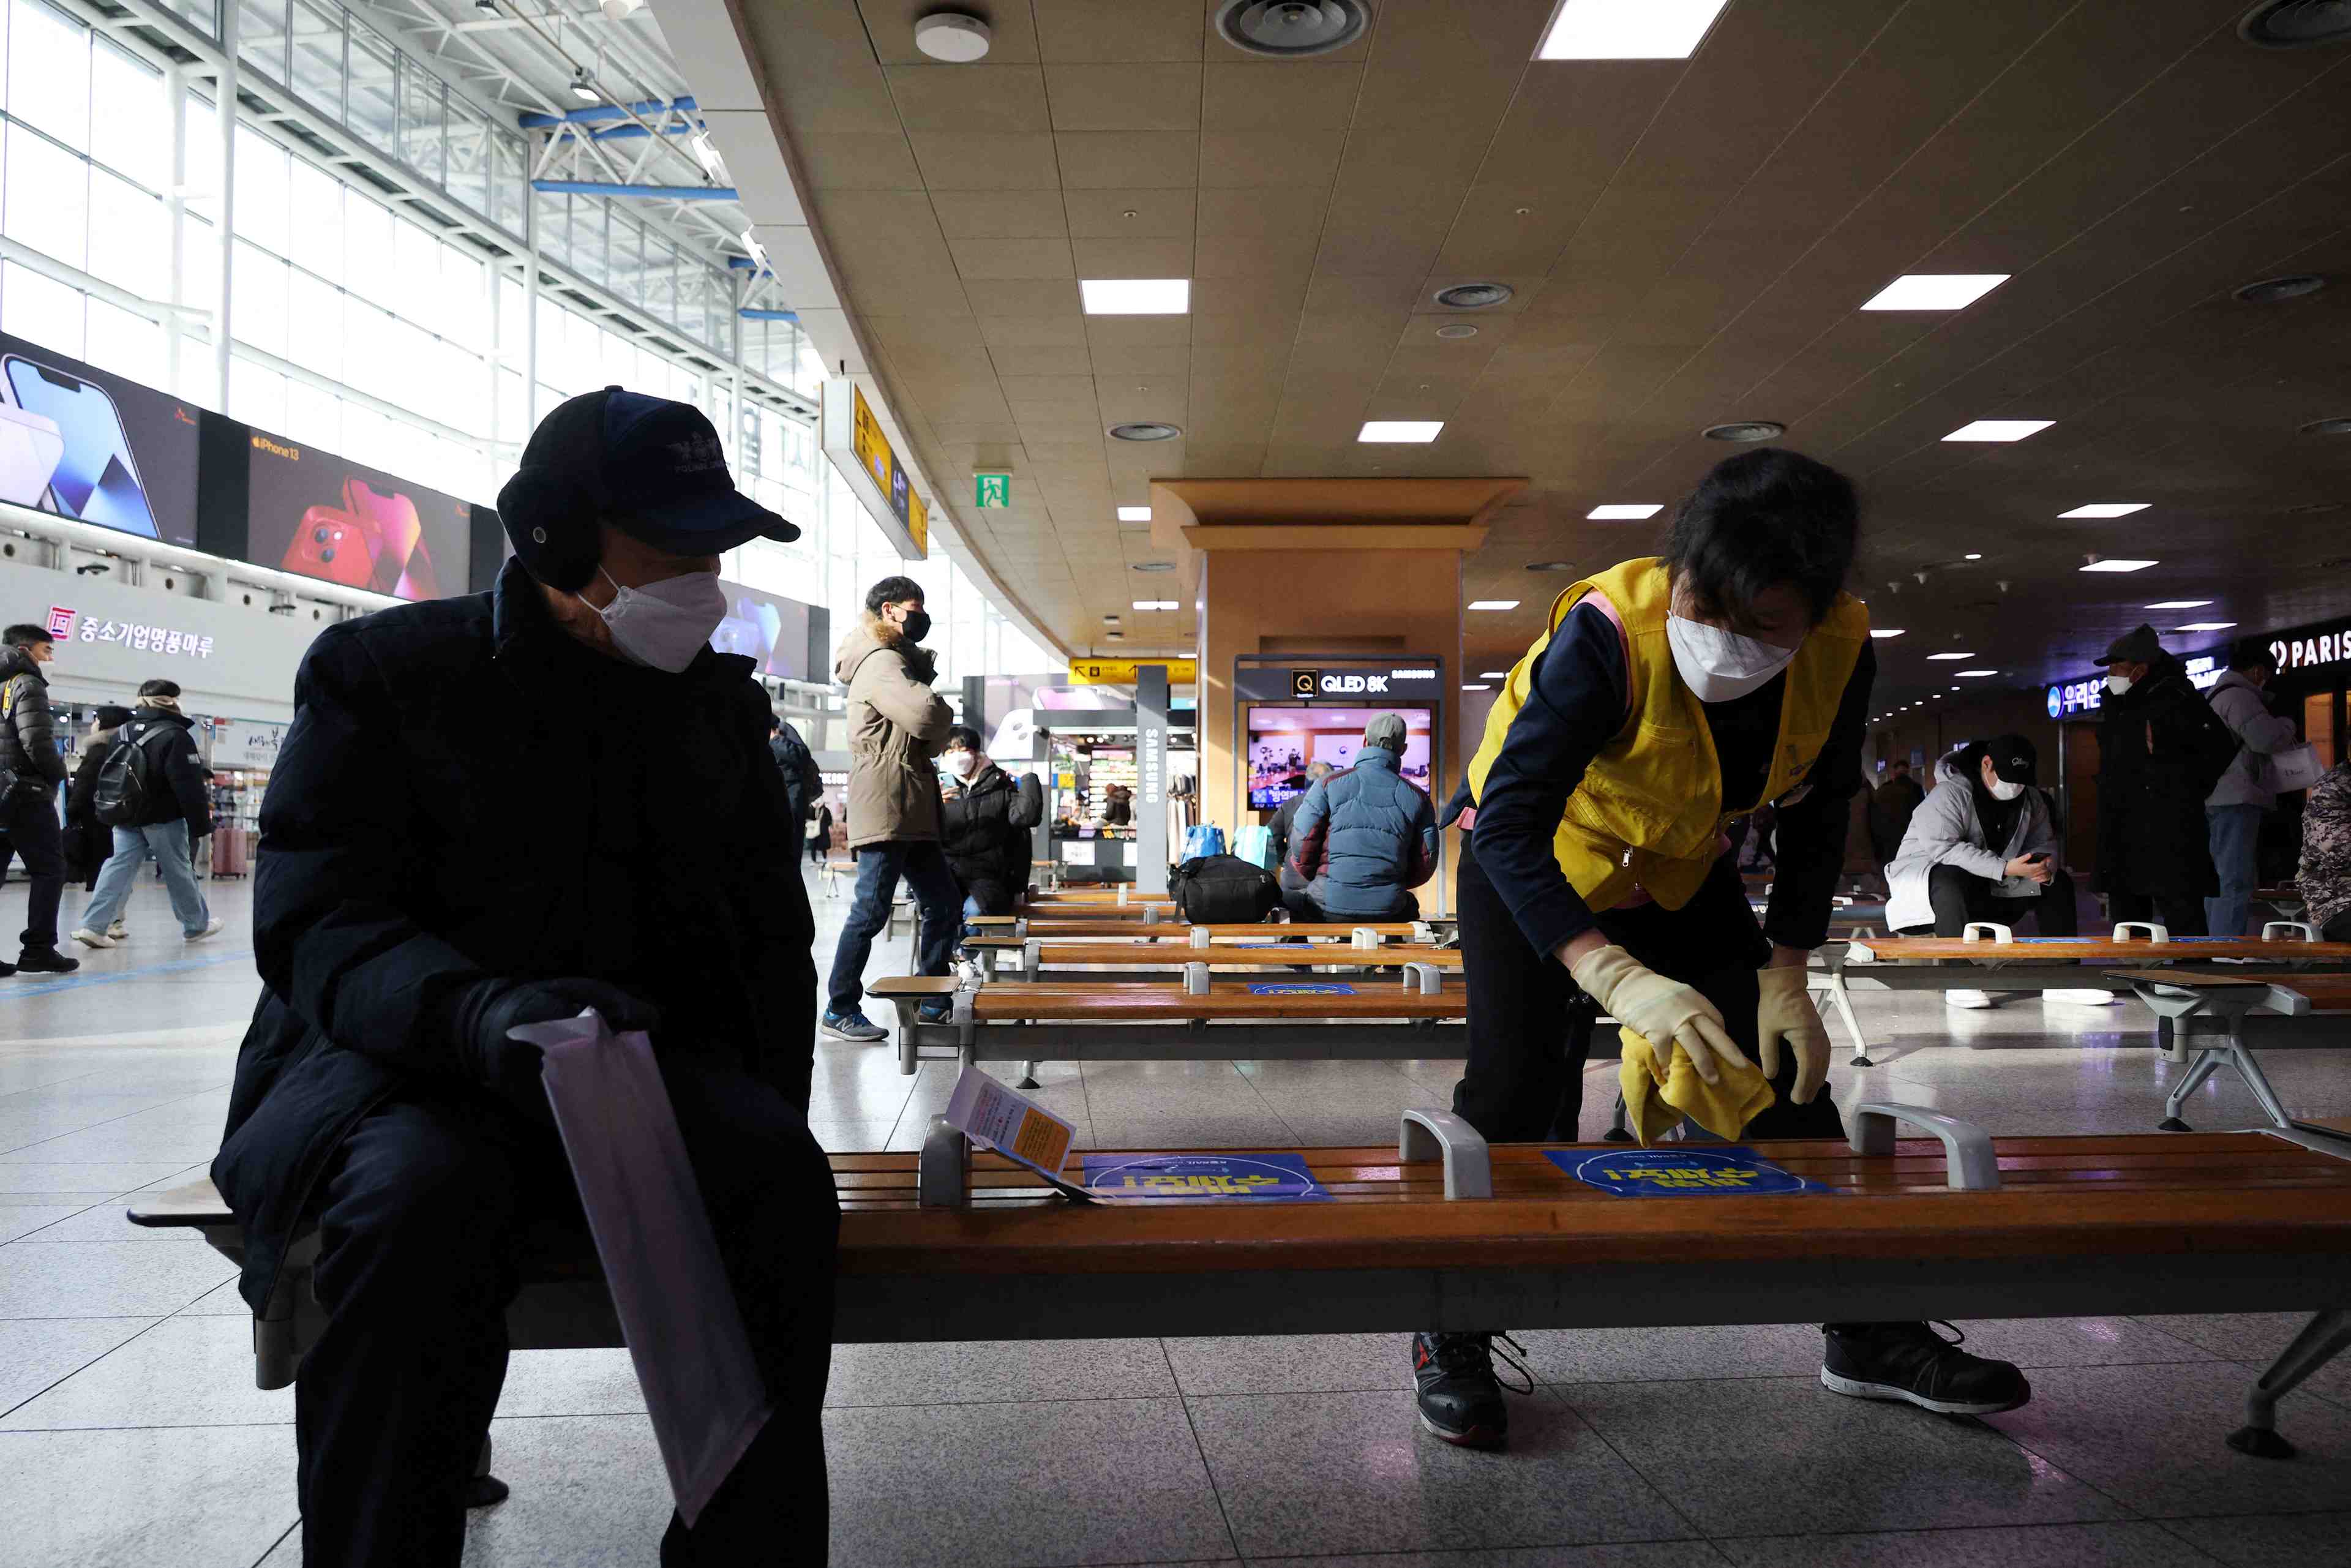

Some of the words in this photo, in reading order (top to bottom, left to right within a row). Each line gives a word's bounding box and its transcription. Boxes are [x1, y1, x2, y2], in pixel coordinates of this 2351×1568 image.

[260, 438, 290, 457] iPhone
[290, 448, 299, 461] 13
[80, 616, 214, 659] 중소기업명품마루
[2291, 629, 2351, 669] PARIS
[1321, 675, 1366, 692] QLED
[1367, 675, 1389, 692] 8K
[2063, 676, 2108, 713] 우리은
[1145, 728, 1159, 803] SAMSUNG
